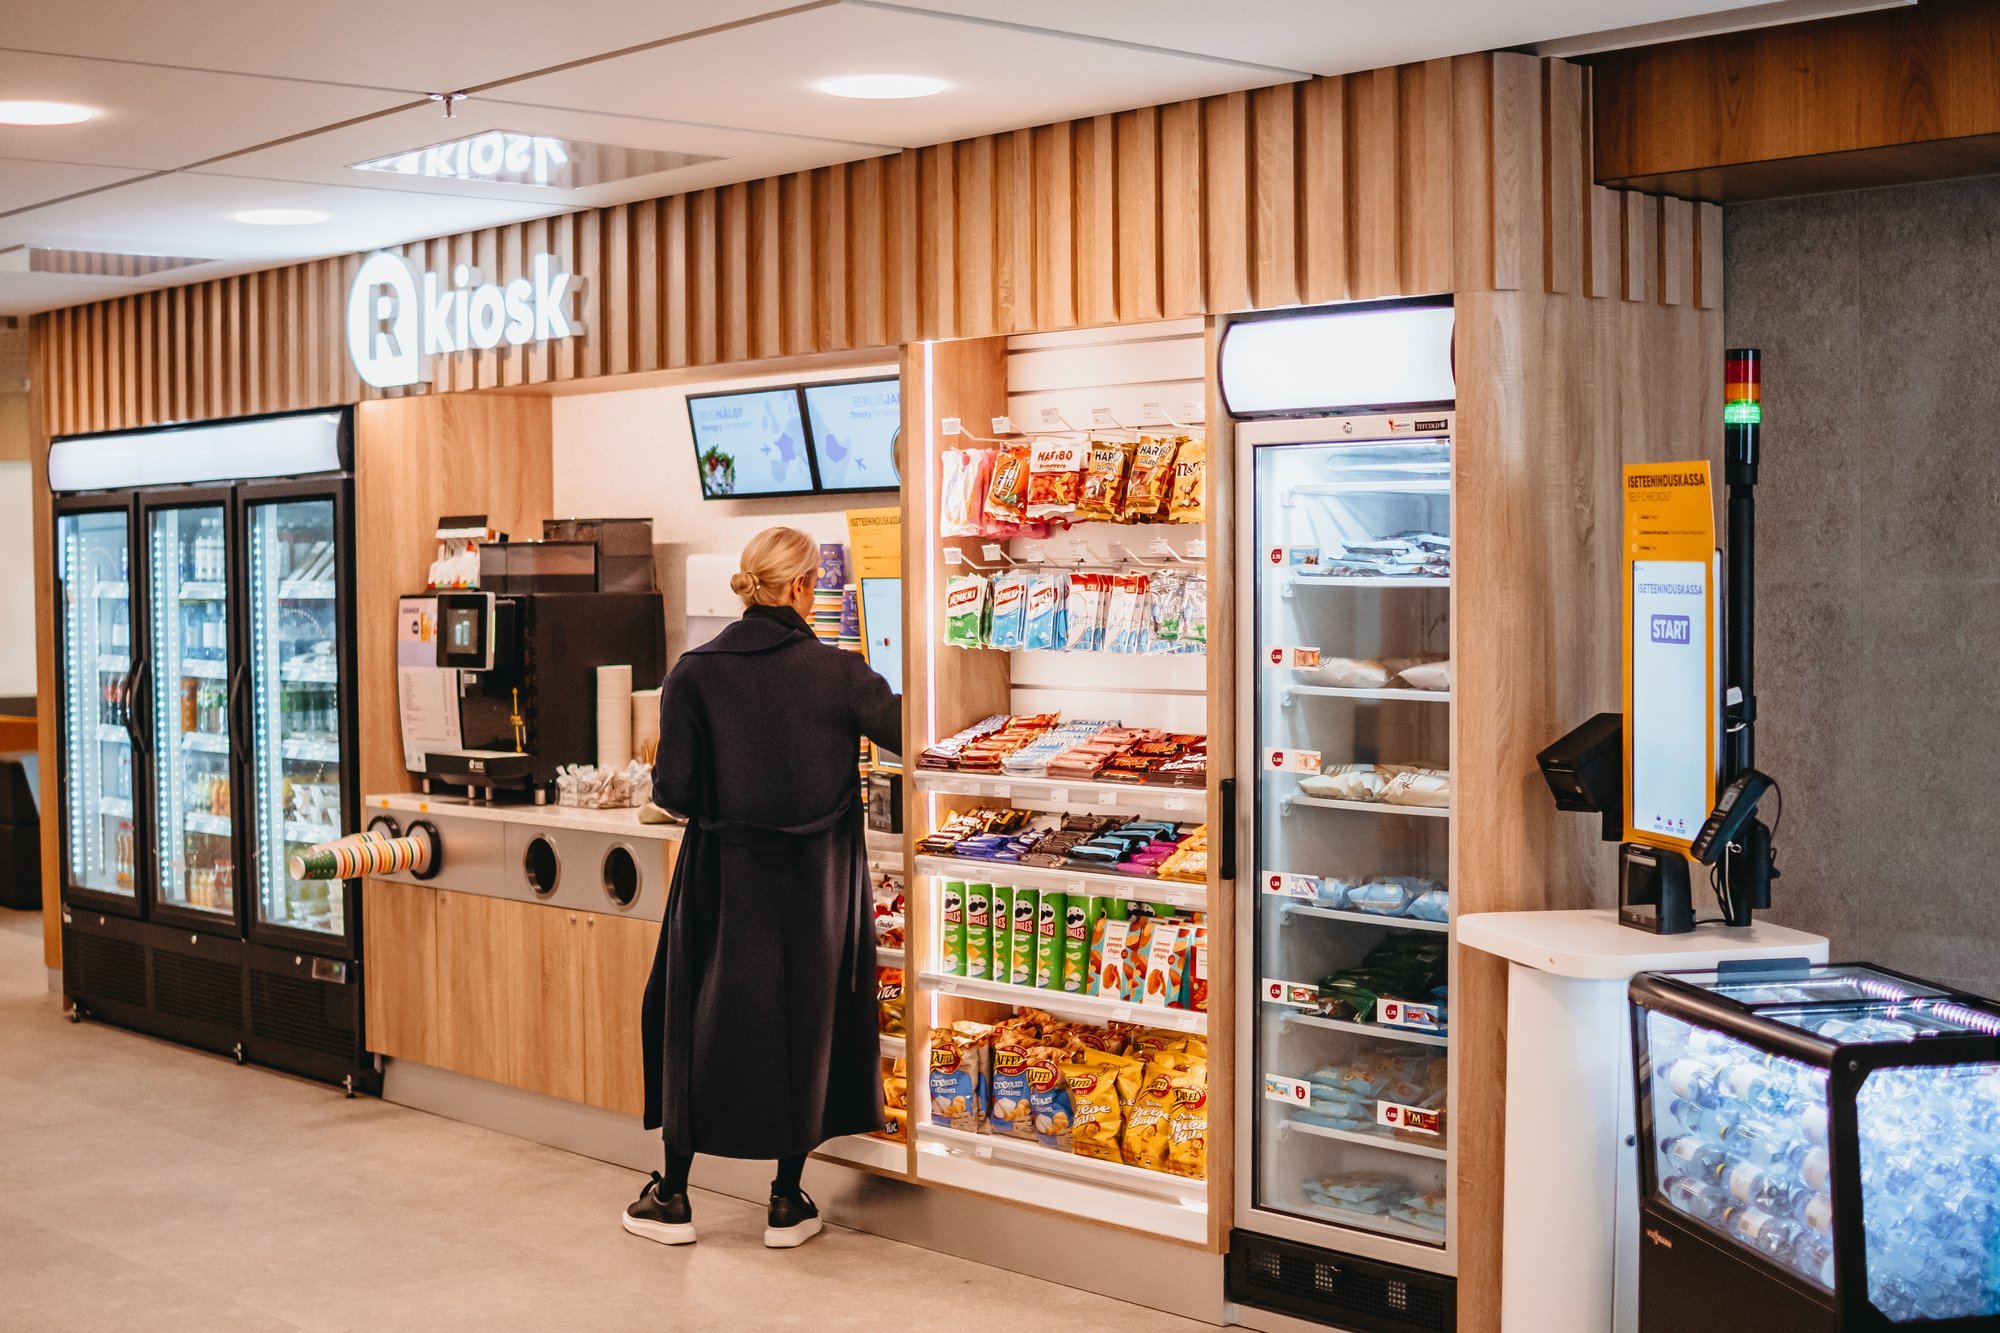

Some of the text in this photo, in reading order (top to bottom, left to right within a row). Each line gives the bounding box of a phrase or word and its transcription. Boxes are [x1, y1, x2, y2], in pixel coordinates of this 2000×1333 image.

[424, 253, 571, 356] kiosk
[1627, 473, 1706, 489] ISETEENINDUSKASSA
[1637, 583, 1703, 596] ISETEENINDUSKASSA
[1652, 618, 1689, 640] START
[882, 985, 900, 998] TUC
[885, 1122, 898, 1133] TUC
